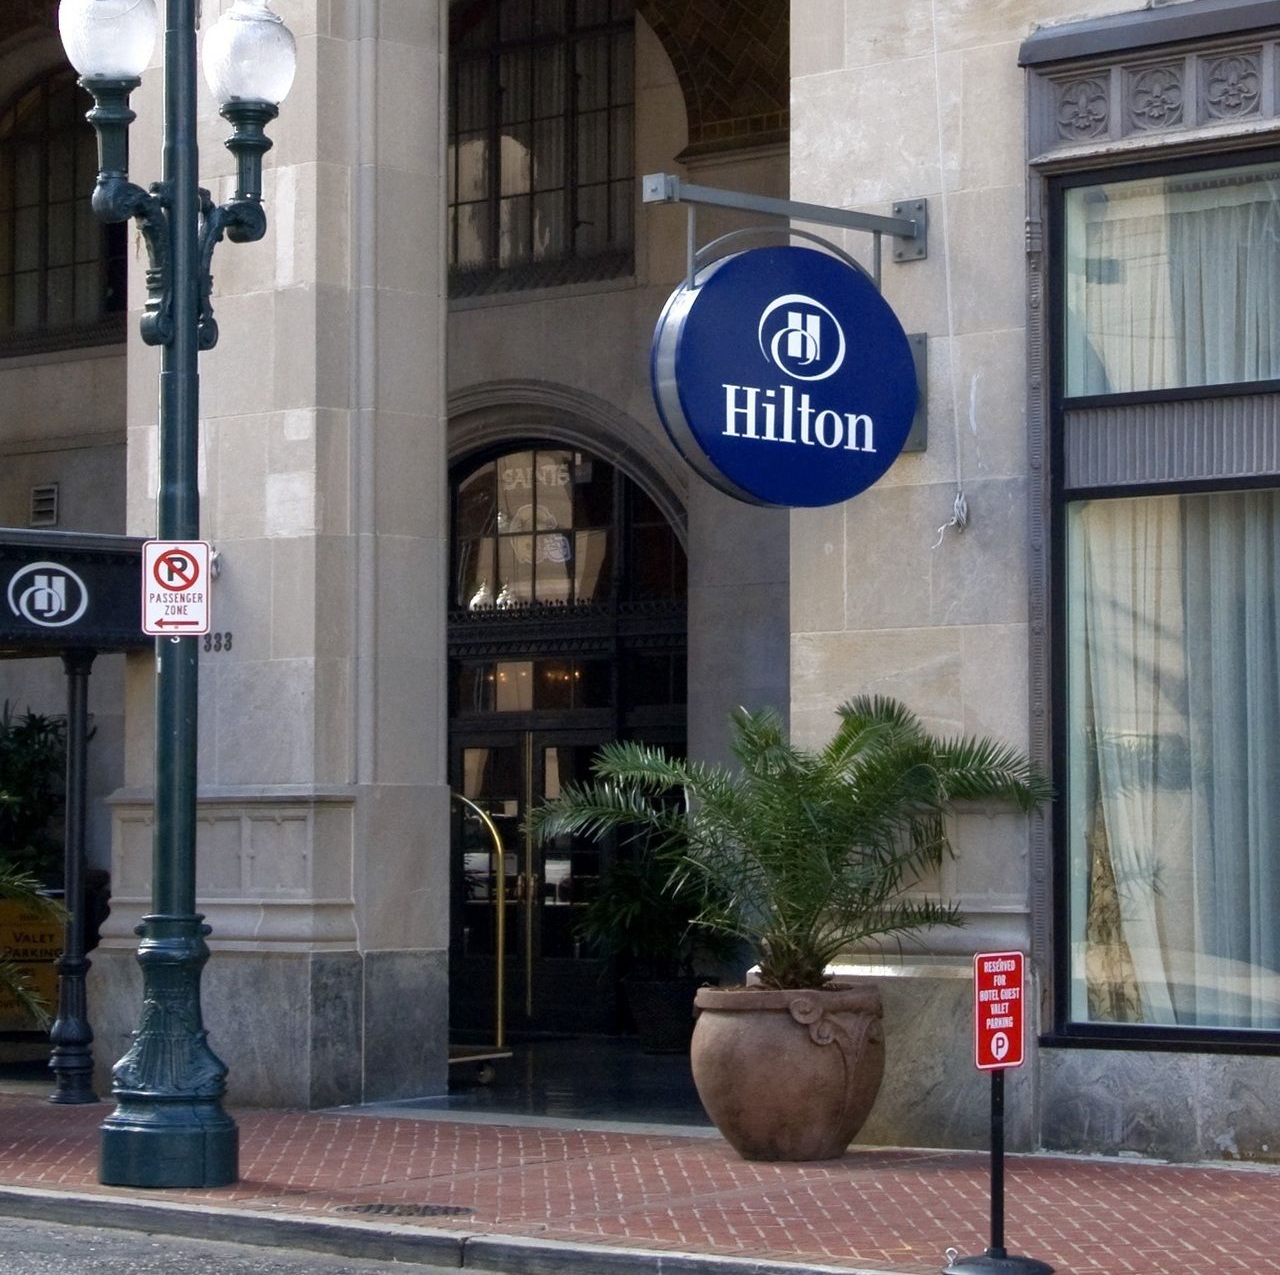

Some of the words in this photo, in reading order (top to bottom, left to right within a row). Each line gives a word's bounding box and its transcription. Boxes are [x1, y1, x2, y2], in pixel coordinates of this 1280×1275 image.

[721, 382, 877, 453] Hilton
[149, 593, 203, 604] PASSENGER
[164, 605, 188, 615] ZONE
[203, 631, 233, 653] 333
[12, 931, 56, 943] VALET
[984, 959, 1015, 973] RESERVED
[993, 974, 1006, 986] FOR
[980, 989, 999, 1002] HOTEL
[1000, 987, 1020, 1000] GUEST
[990, 1003, 1009, 1015] VALET
[986, 1016, 1013, 1029] PARKING
